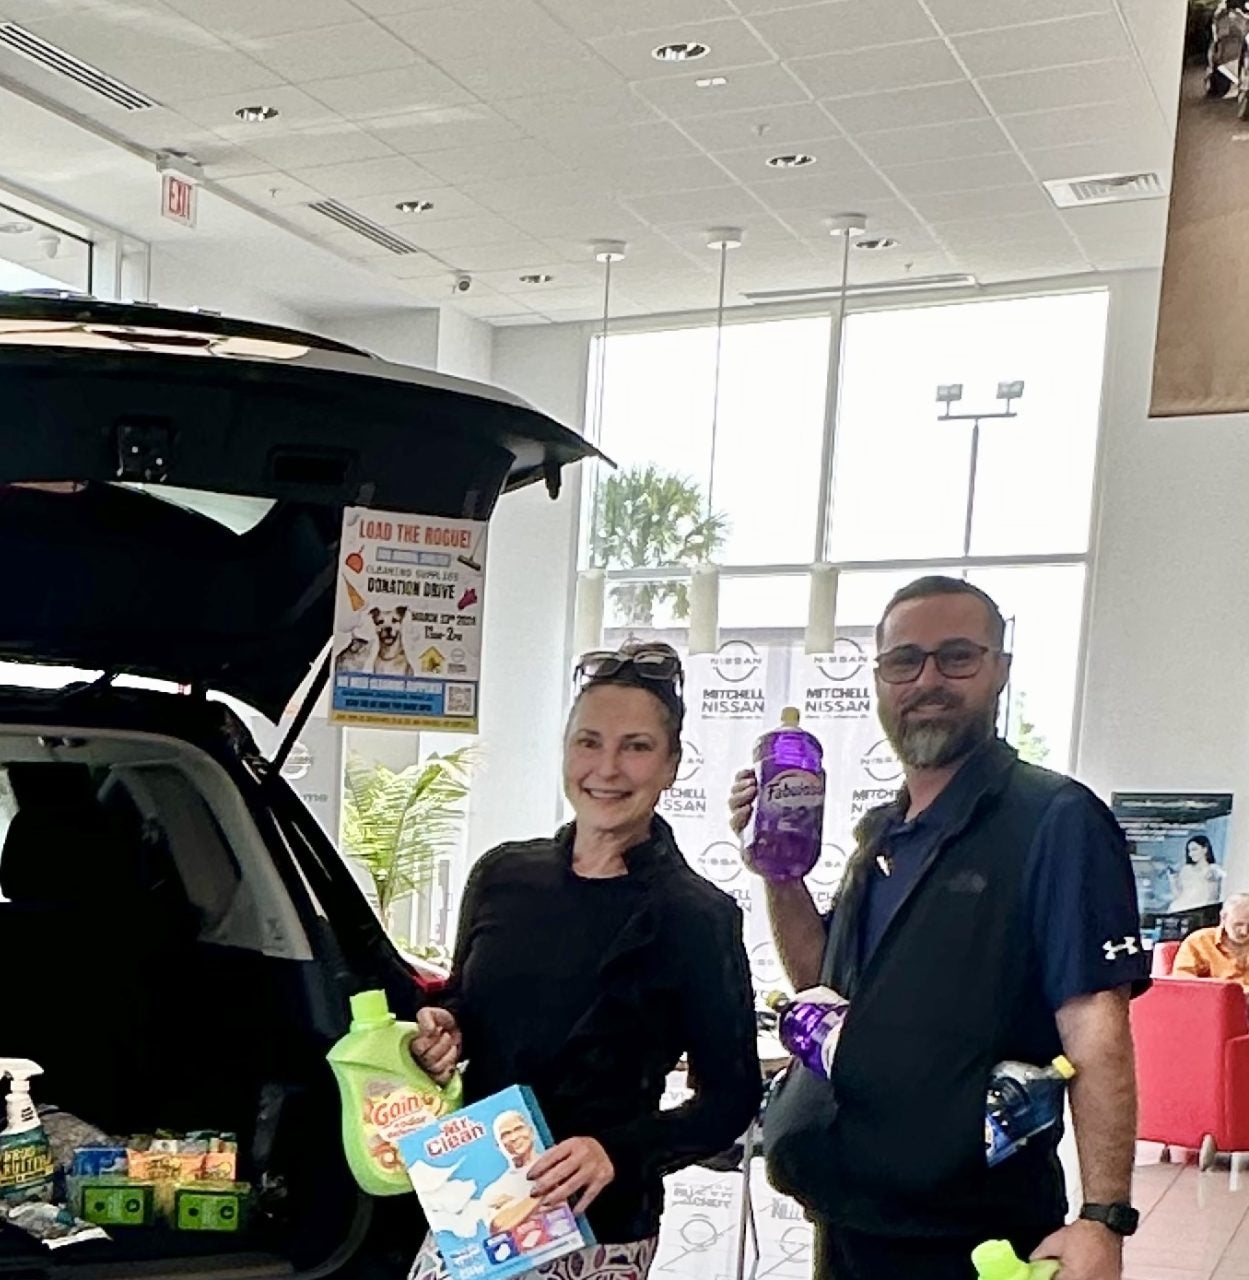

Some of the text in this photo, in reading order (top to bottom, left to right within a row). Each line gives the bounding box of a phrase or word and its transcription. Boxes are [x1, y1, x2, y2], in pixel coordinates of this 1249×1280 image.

[169, 176, 192, 220] EXIT
[359, 519, 471, 548] LOAD THE ROGUE!
[367, 577, 456, 599] DONATION DRIVE
[710, 656, 762, 665] NISSAN
[814, 655, 868, 664] NISSAN
[702, 687, 765, 700] MITCHELL
[806, 686, 870, 699] MITCHELL
[702, 701, 765, 713] NISSAN
[805, 700, 870, 713] NISSAN
[662, 800, 707, 812] SSAN
[374, 1095, 420, 1126] Gain
[427, 1125, 484, 1156] Clean
